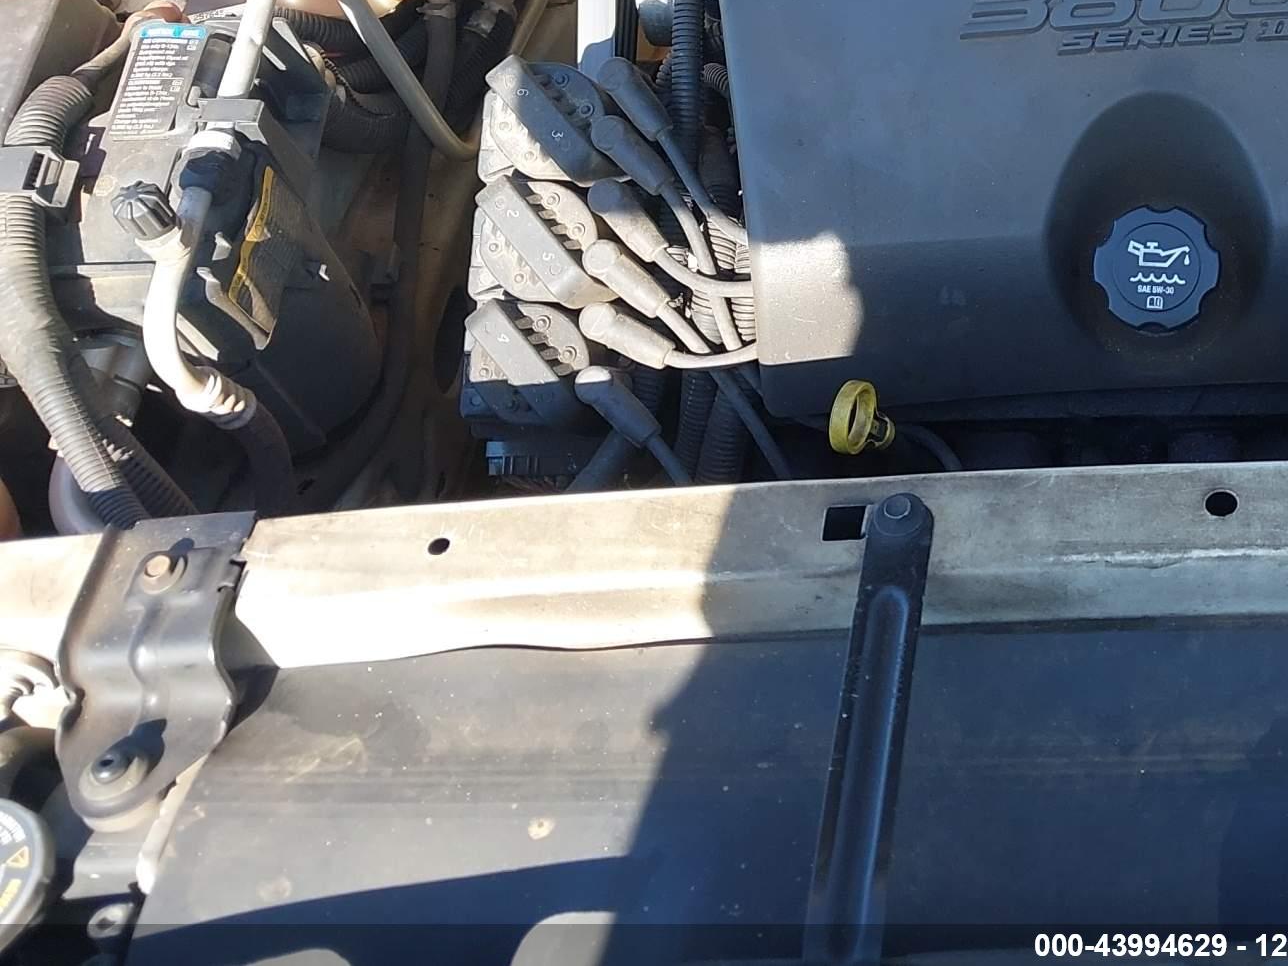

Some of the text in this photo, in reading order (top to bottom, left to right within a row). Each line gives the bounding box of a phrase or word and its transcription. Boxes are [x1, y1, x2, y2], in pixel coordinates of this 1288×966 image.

[1057, 21, 1248, 56] SERIES
[551, 130, 564, 140] 3
[506, 208, 520, 219] 2
[1137, 284, 1151, 294] SAE
